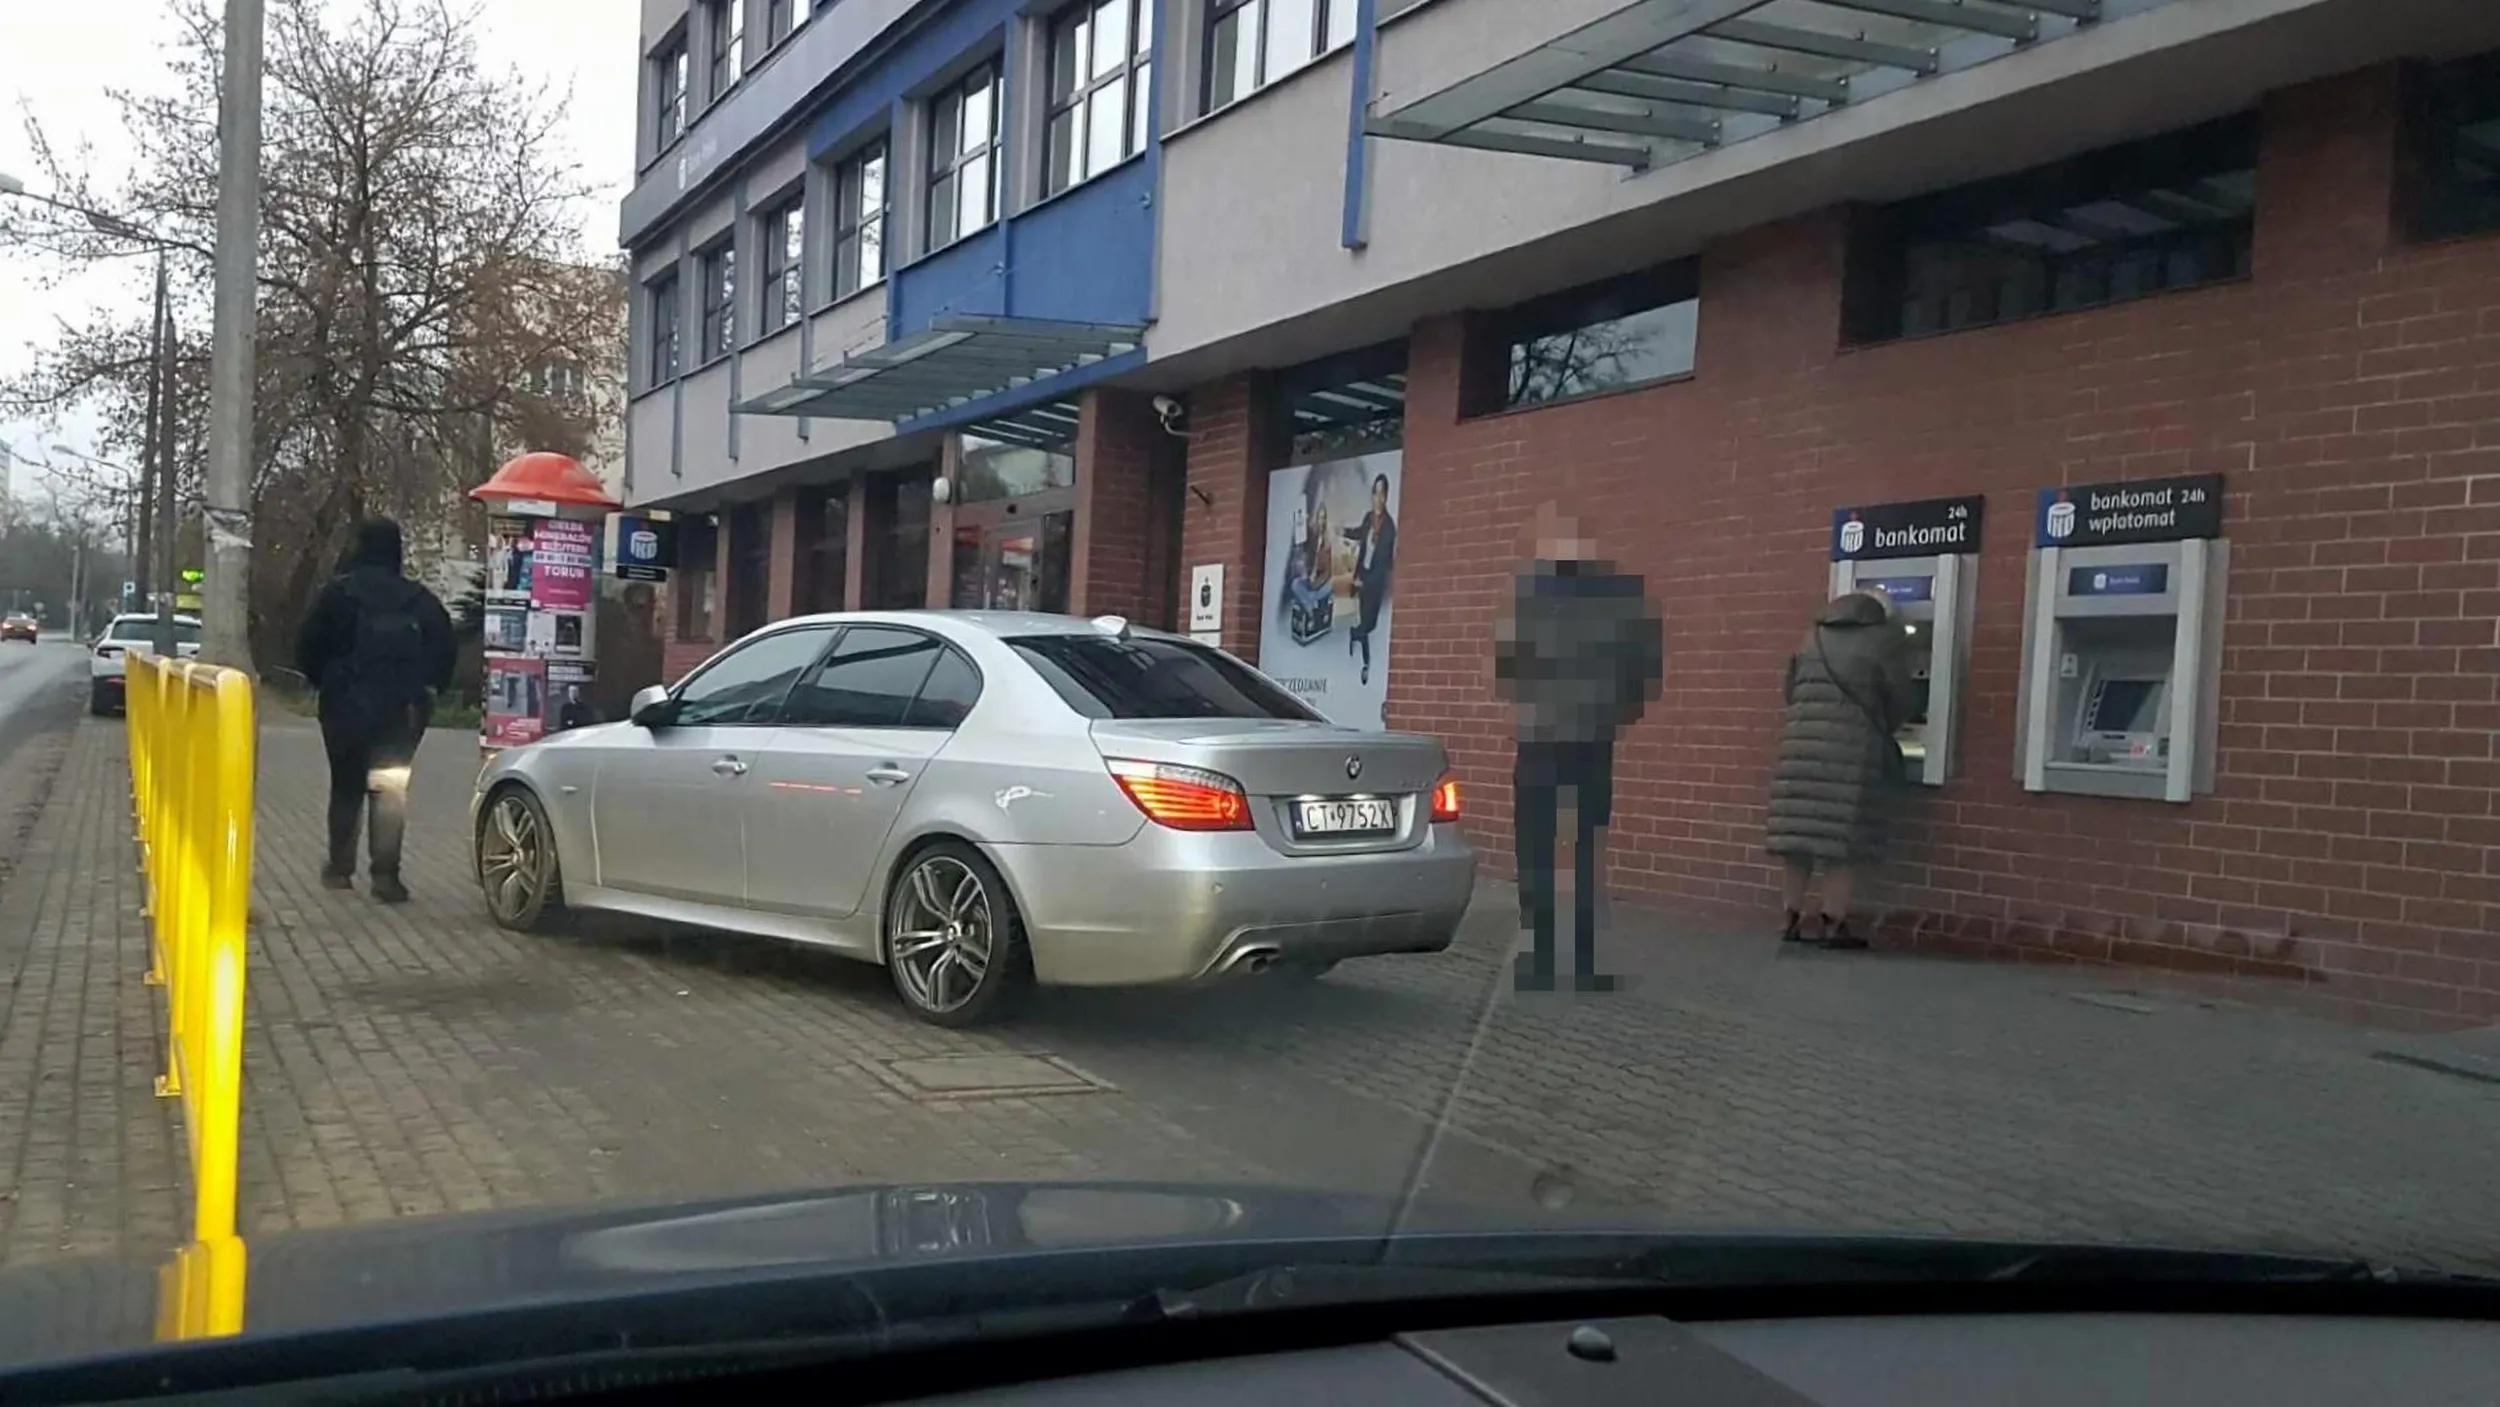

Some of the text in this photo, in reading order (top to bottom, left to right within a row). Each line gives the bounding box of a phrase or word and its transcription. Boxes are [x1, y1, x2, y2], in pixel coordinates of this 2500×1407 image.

[1948, 506, 1967, 519] 24h
[2091, 488, 2205, 511] bankomat 24h
[1875, 522, 1967, 548] bankomat
[2089, 509, 2176, 535] wpłatomat
[1336, 803, 1391, 829] 9752X
